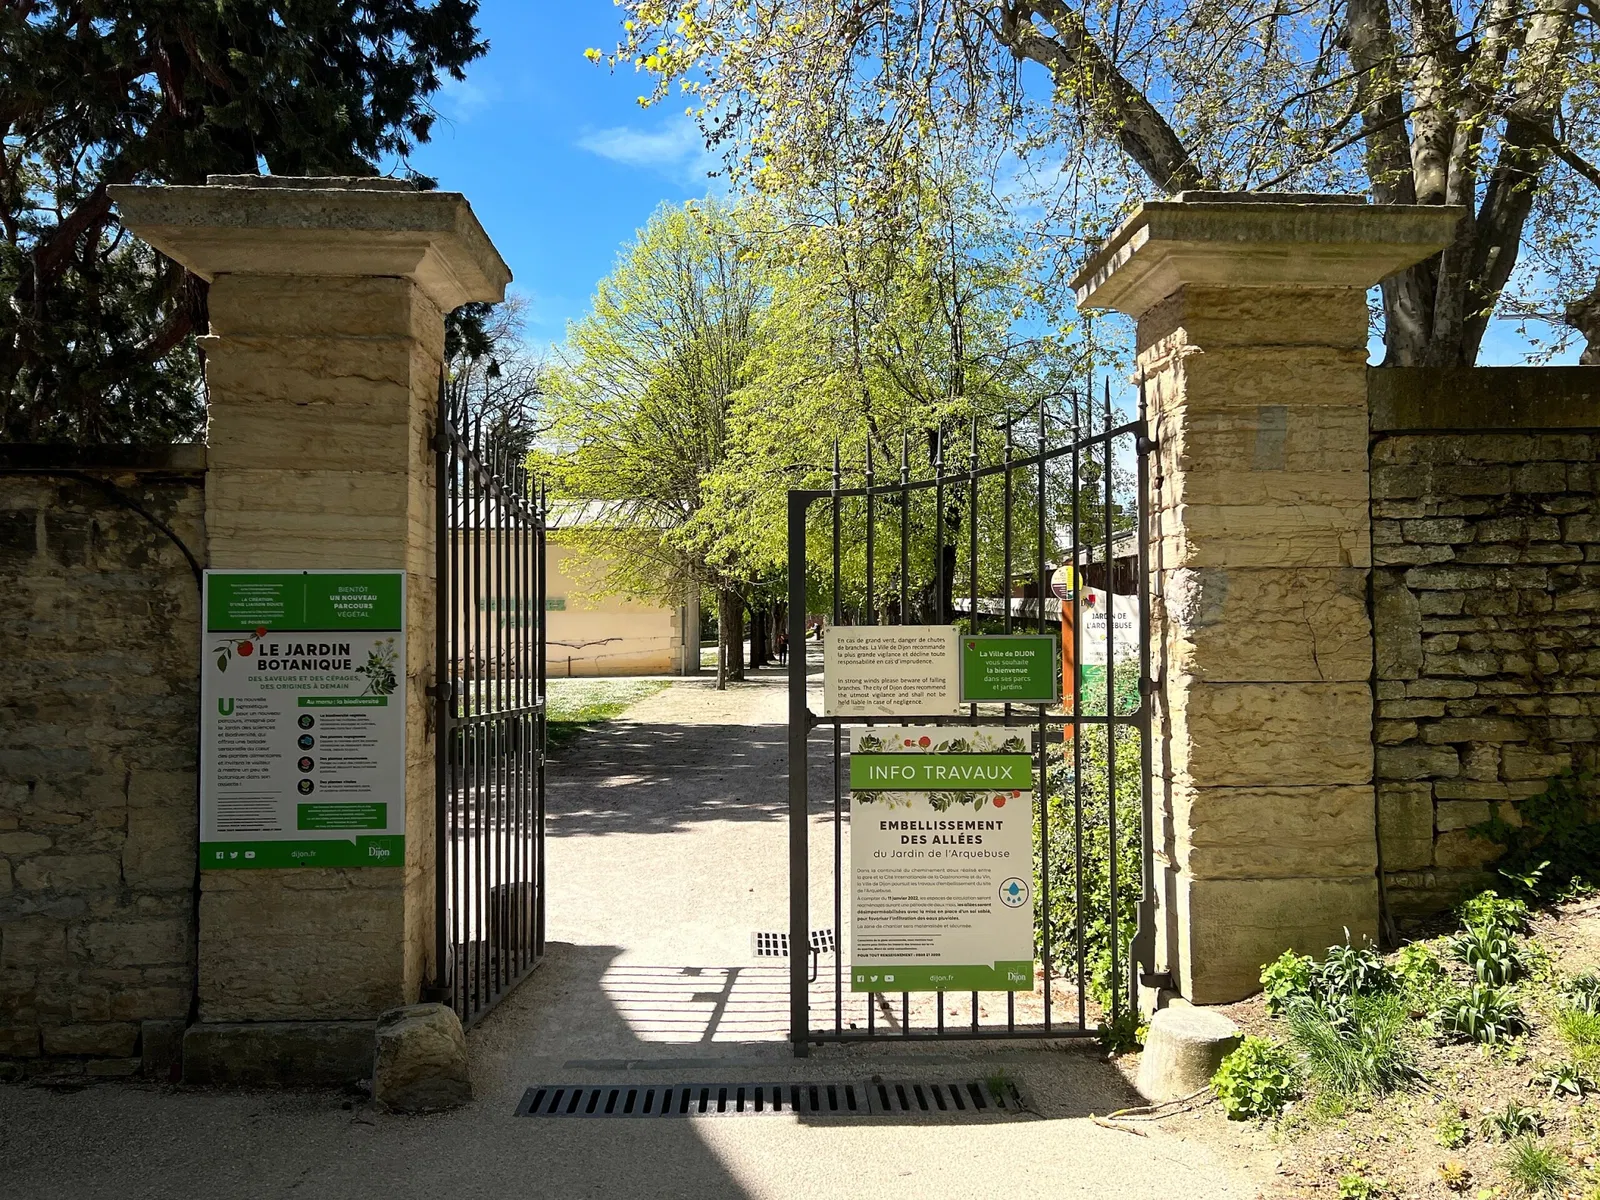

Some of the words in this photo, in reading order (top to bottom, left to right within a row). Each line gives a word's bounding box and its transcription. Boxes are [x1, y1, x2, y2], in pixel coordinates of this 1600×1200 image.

[259, 644, 278, 656] LE
[285, 644, 350, 656] JARDIN
[258, 659, 352, 670] BOTANIQUE
[870, 766, 915, 779] INFO
[923, 766, 1013, 779] TRAVAUX
[880, 821, 1004, 830] EMBELLISSEMENT
[901, 835, 926, 844] DES
[932, 833, 983, 844] ALLÉES
[368, 847, 390, 859] Dijon
[874, 850, 887, 858] du
[946, 850, 1010, 859] l'Arquebuse
[1008, 972, 1026, 982] Dijon
